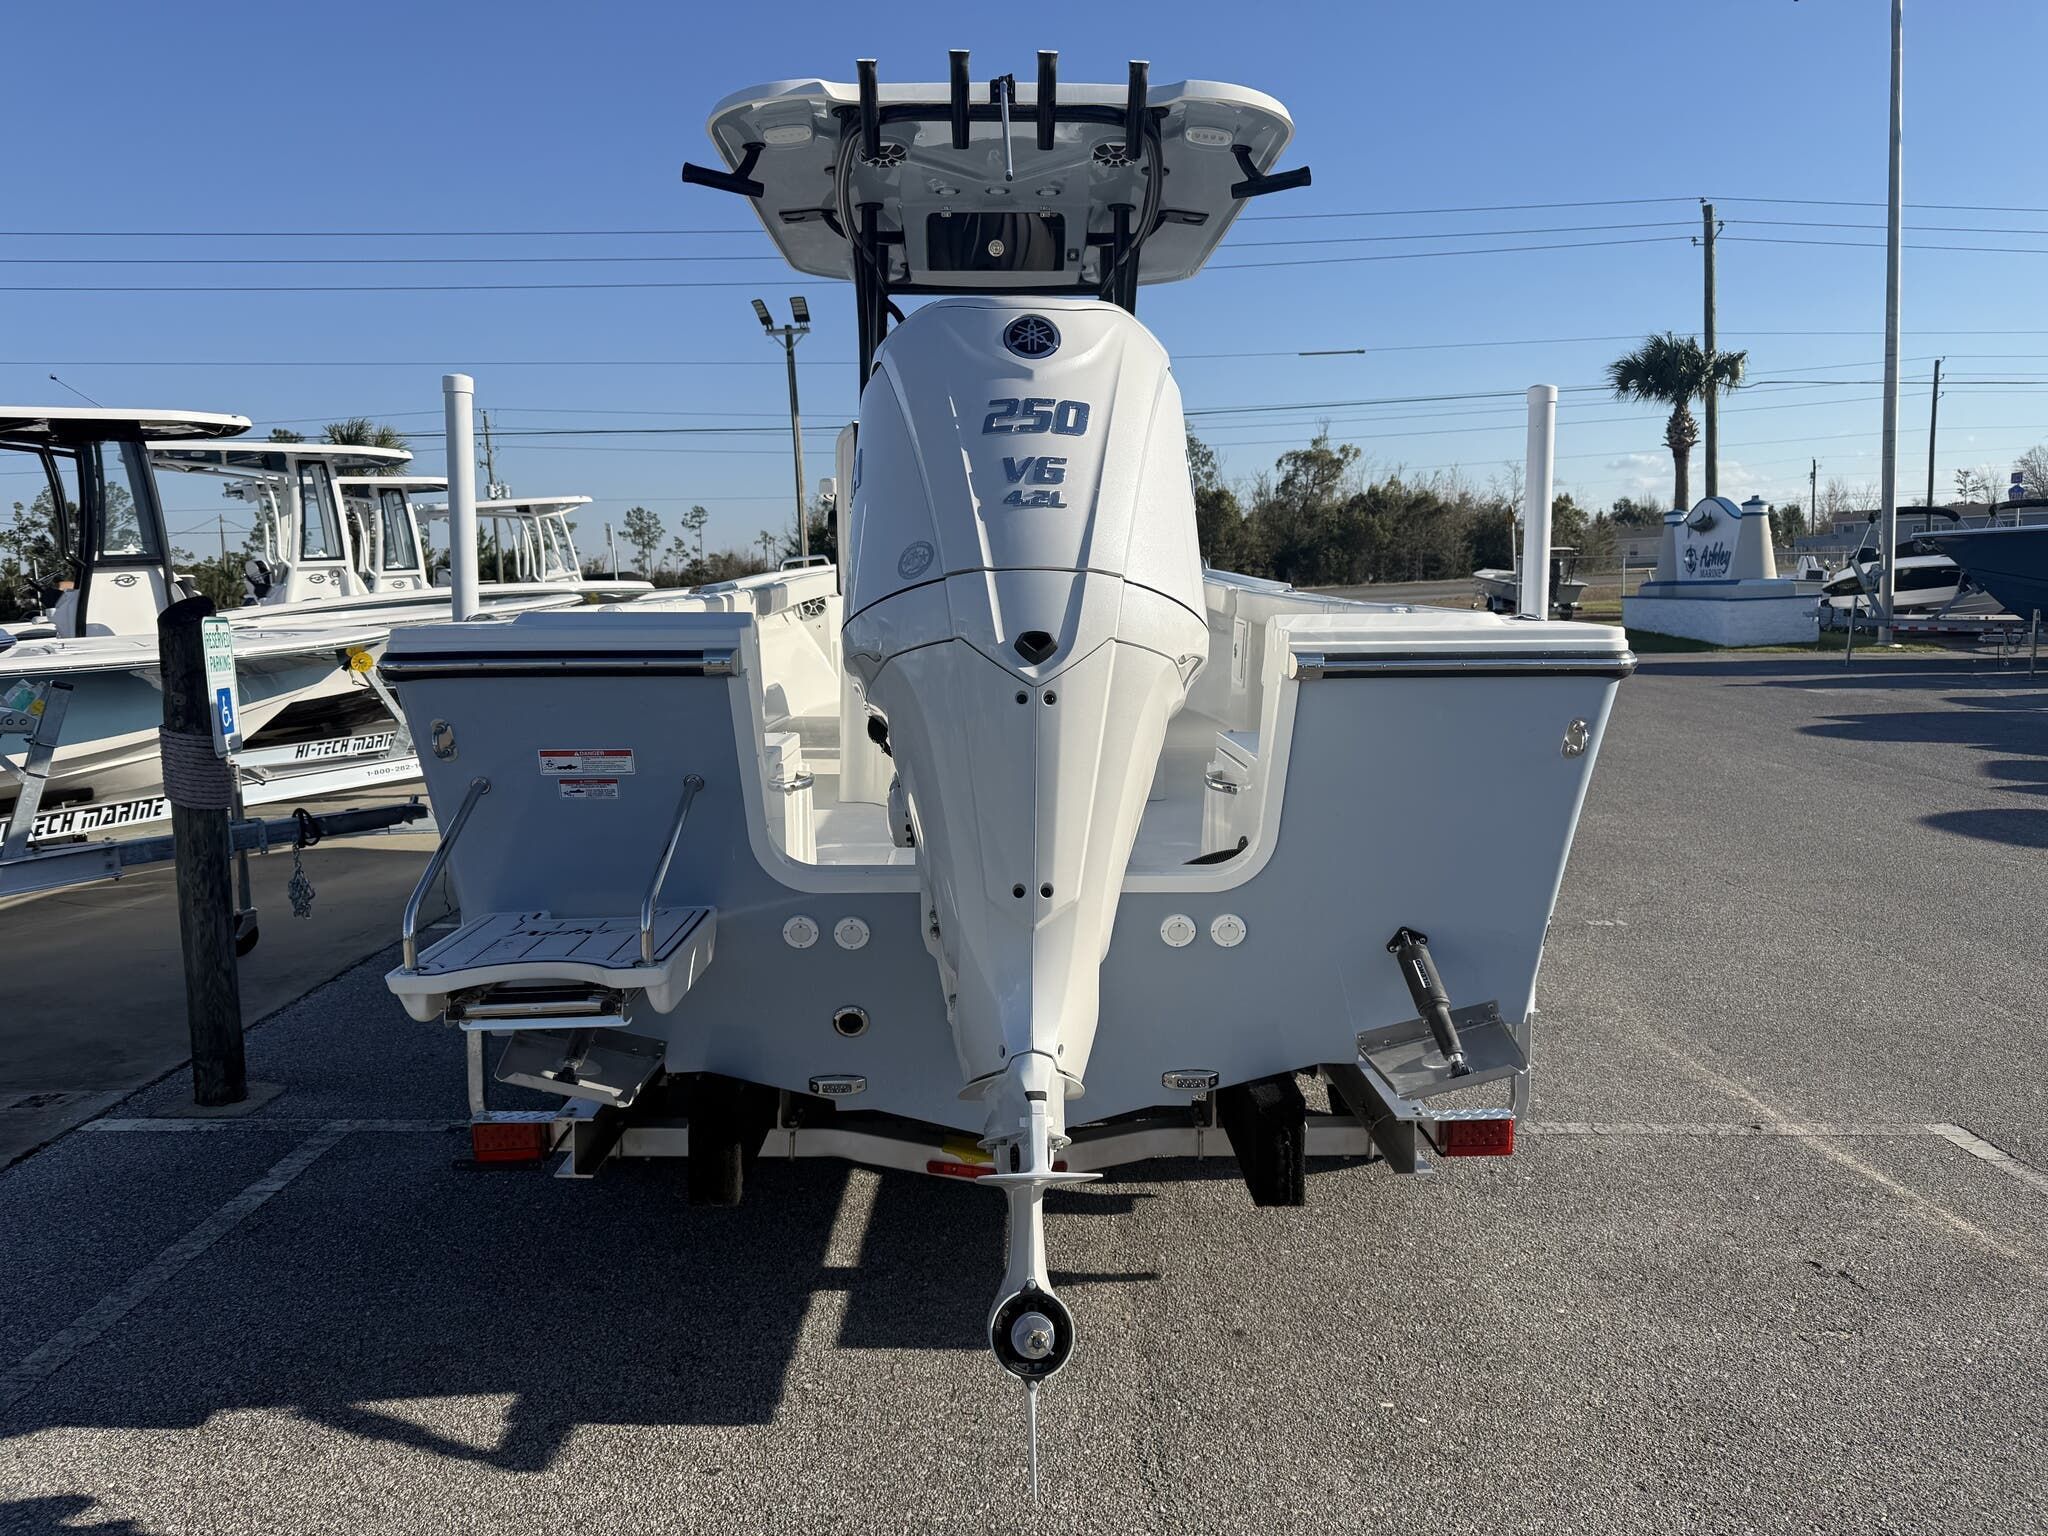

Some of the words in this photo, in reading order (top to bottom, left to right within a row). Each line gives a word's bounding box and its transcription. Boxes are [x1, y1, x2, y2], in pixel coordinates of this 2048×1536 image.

[982, 398, 1090, 436] 250
[1002, 456, 1068, 485] V6
[1700, 541, 1731, 574] Ashley
[205, 631, 230, 649] RESERVED
[209, 655, 232, 673] PARKING
[295, 739, 349, 759] HI-TECH
